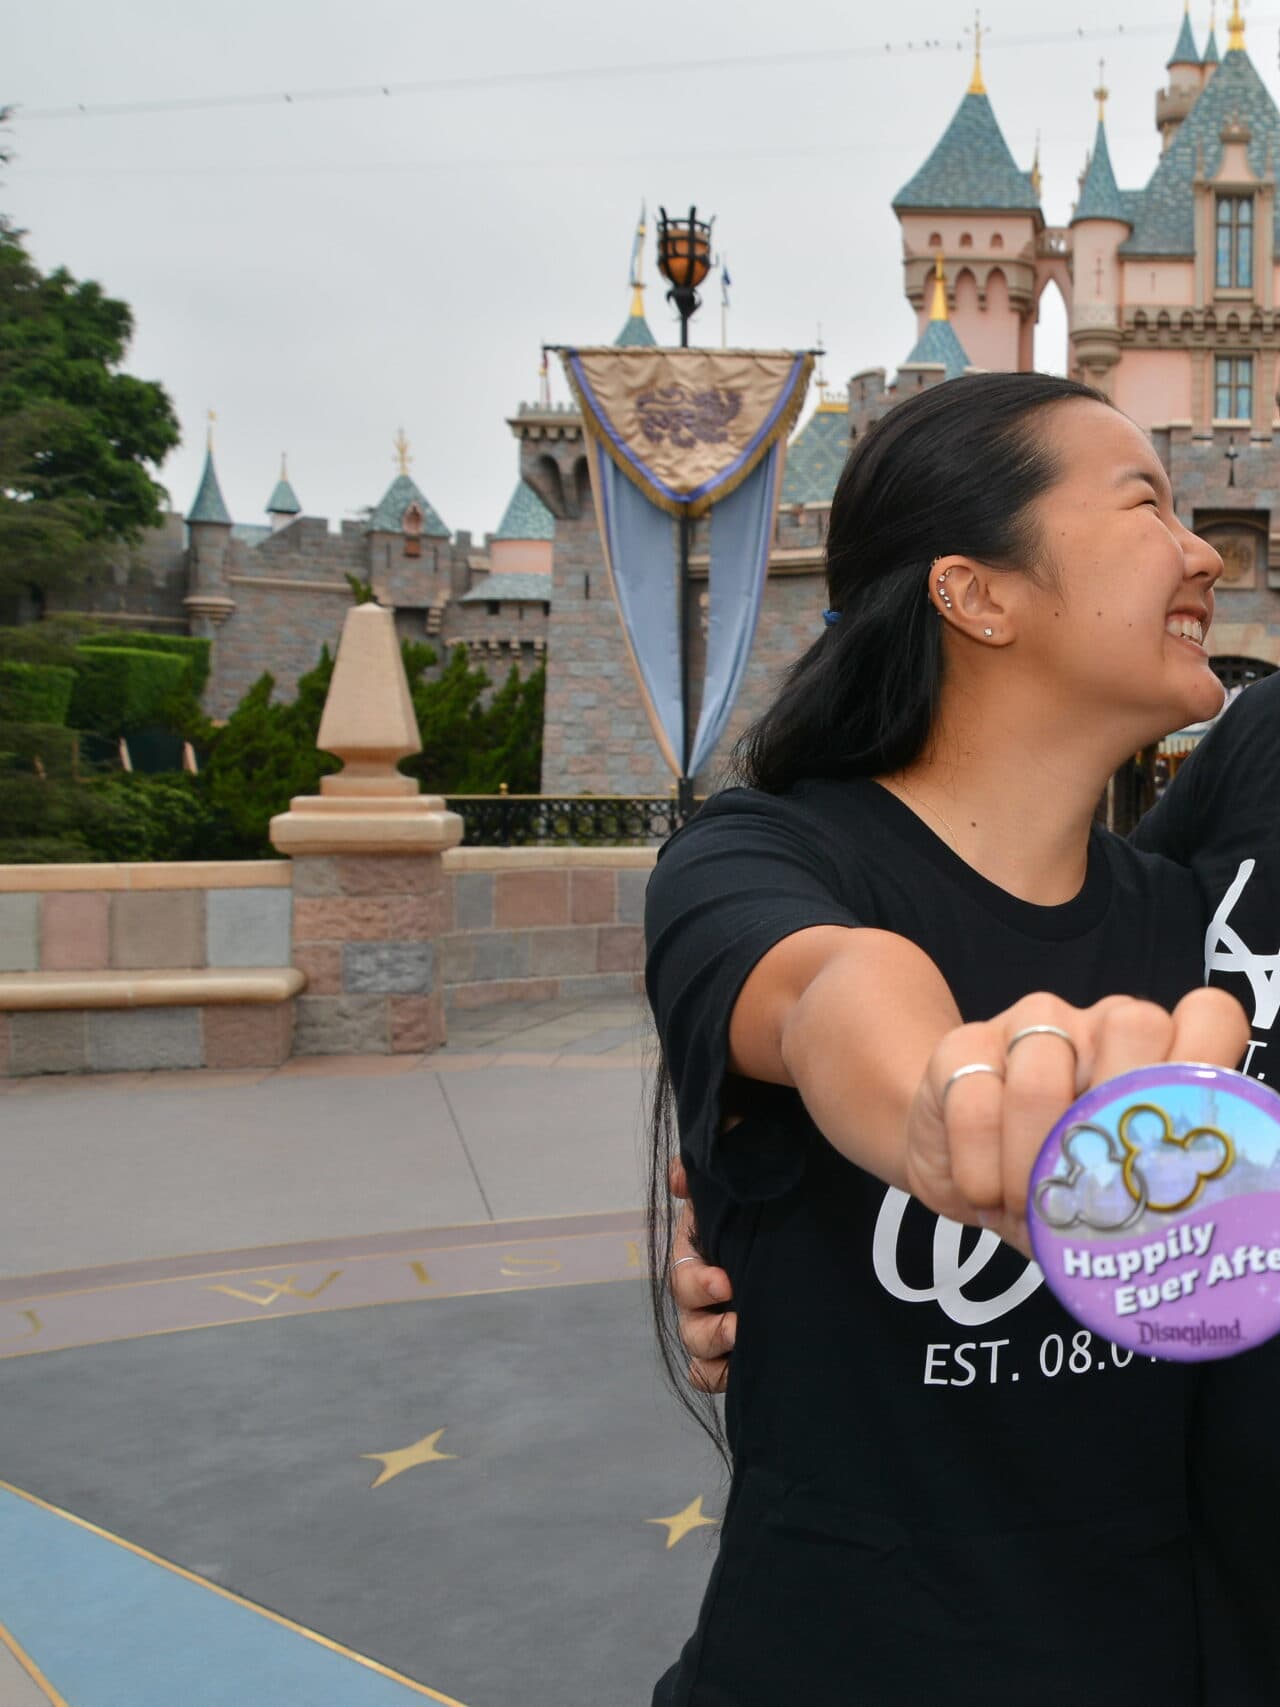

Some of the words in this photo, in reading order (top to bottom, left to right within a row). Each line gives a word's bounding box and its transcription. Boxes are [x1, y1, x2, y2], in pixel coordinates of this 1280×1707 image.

[1062, 1220, 1216, 1282] Happily
[1114, 1266, 1200, 1317] Ever
[1134, 1318, 1245, 1346] Disneyland
[923, 1338, 1020, 1387] EST.
